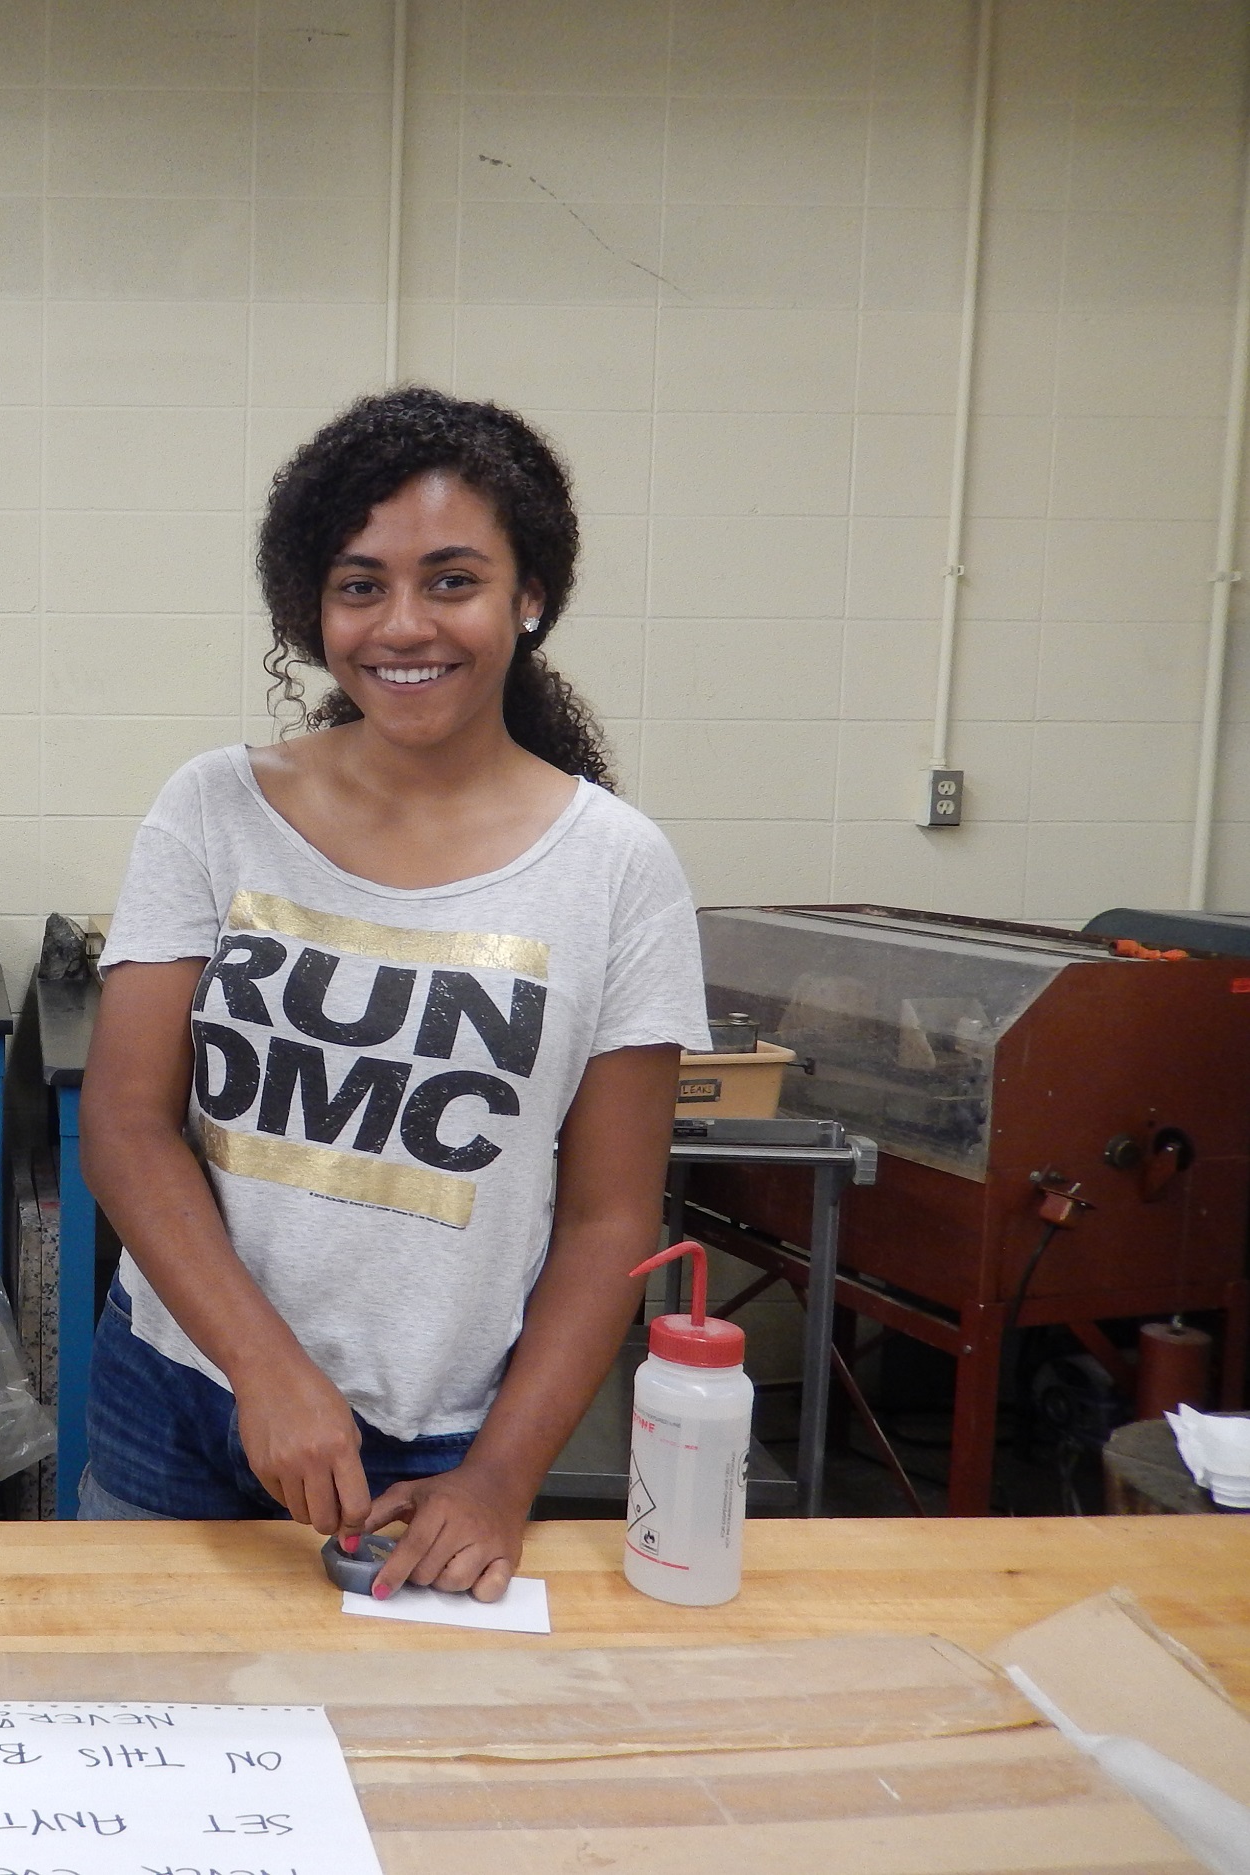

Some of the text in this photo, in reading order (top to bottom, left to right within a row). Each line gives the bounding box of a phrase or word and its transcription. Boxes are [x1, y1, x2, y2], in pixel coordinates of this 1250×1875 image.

[193, 934, 548, 1079] RUN
[192, 1019, 521, 1172] DMC
[78, 1745, 186, 1768] THIS
[225, 1750, 282, 1773] ON
[202, 1813, 293, 1835] SET
